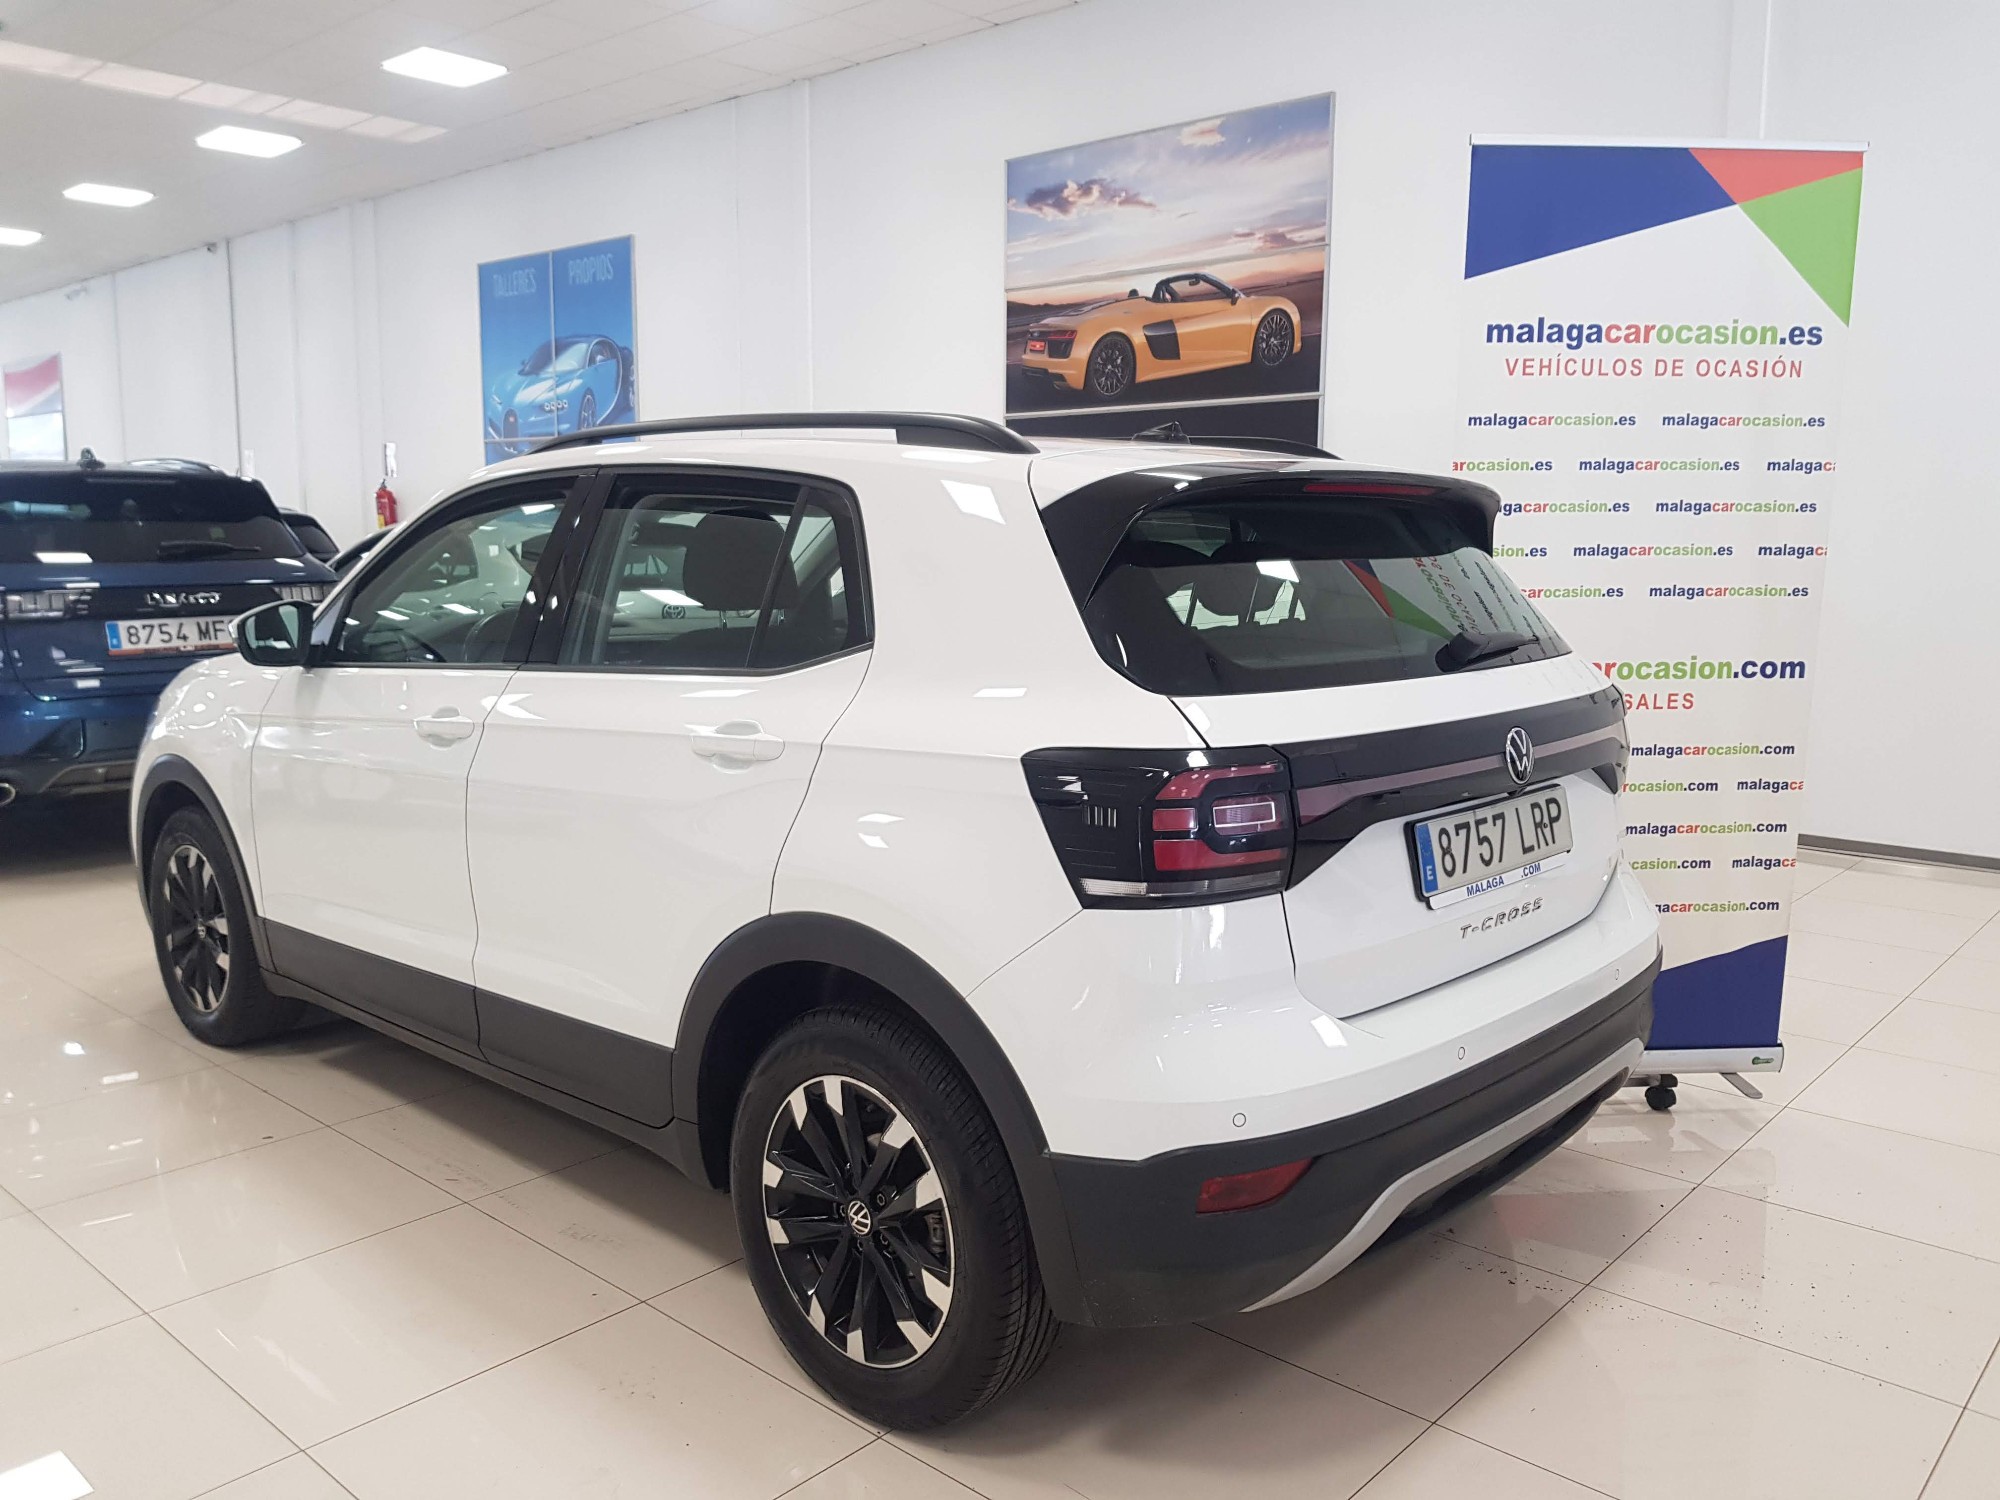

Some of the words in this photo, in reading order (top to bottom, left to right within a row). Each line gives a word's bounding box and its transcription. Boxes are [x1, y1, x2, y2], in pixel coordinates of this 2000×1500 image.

[493, 267, 537, 298] TALLERES
[568, 253, 614, 285] PROPIOS
[1486, 317, 1823, 350] malagacarocasion.es
[1505, 353, 1642, 376] VEHÍCULOS
[1655, 359, 1684, 376] DE
[1696, 355, 1802, 378] OCASIÓN
[1468, 413, 1636, 429] malagacarocasion.es
[1662, 413, 1825, 429] malagacarocasion.es
[1579, 458, 1740, 474] malagacarocasion.es
[1656, 499, 1817, 515] malagacarocasion.es
[1574, 543, 1733, 559] malagacarocasion.es
[1649, 584, 1809, 600] malagacarocasion.es
[127, 621, 190, 645] 8754
[196, 620, 236, 642] MF
[1592, 656, 1806, 680] rocasion.com
[1624, 692, 1694, 710] SALES
[1631, 741, 1796, 760] malagacarocasion.com
[1625, 821, 1788, 837] malagacarocasion.com
[1426, 864, 1434, 881] E
[1438, 811, 1506, 878] 8757
[1515, 797, 1563, 855] LRP
[1466, 874, 1505, 898] MALAGA
[1521, 861, 1541, 879] .COM
[1460, 896, 1543, 939] T-CROSS
